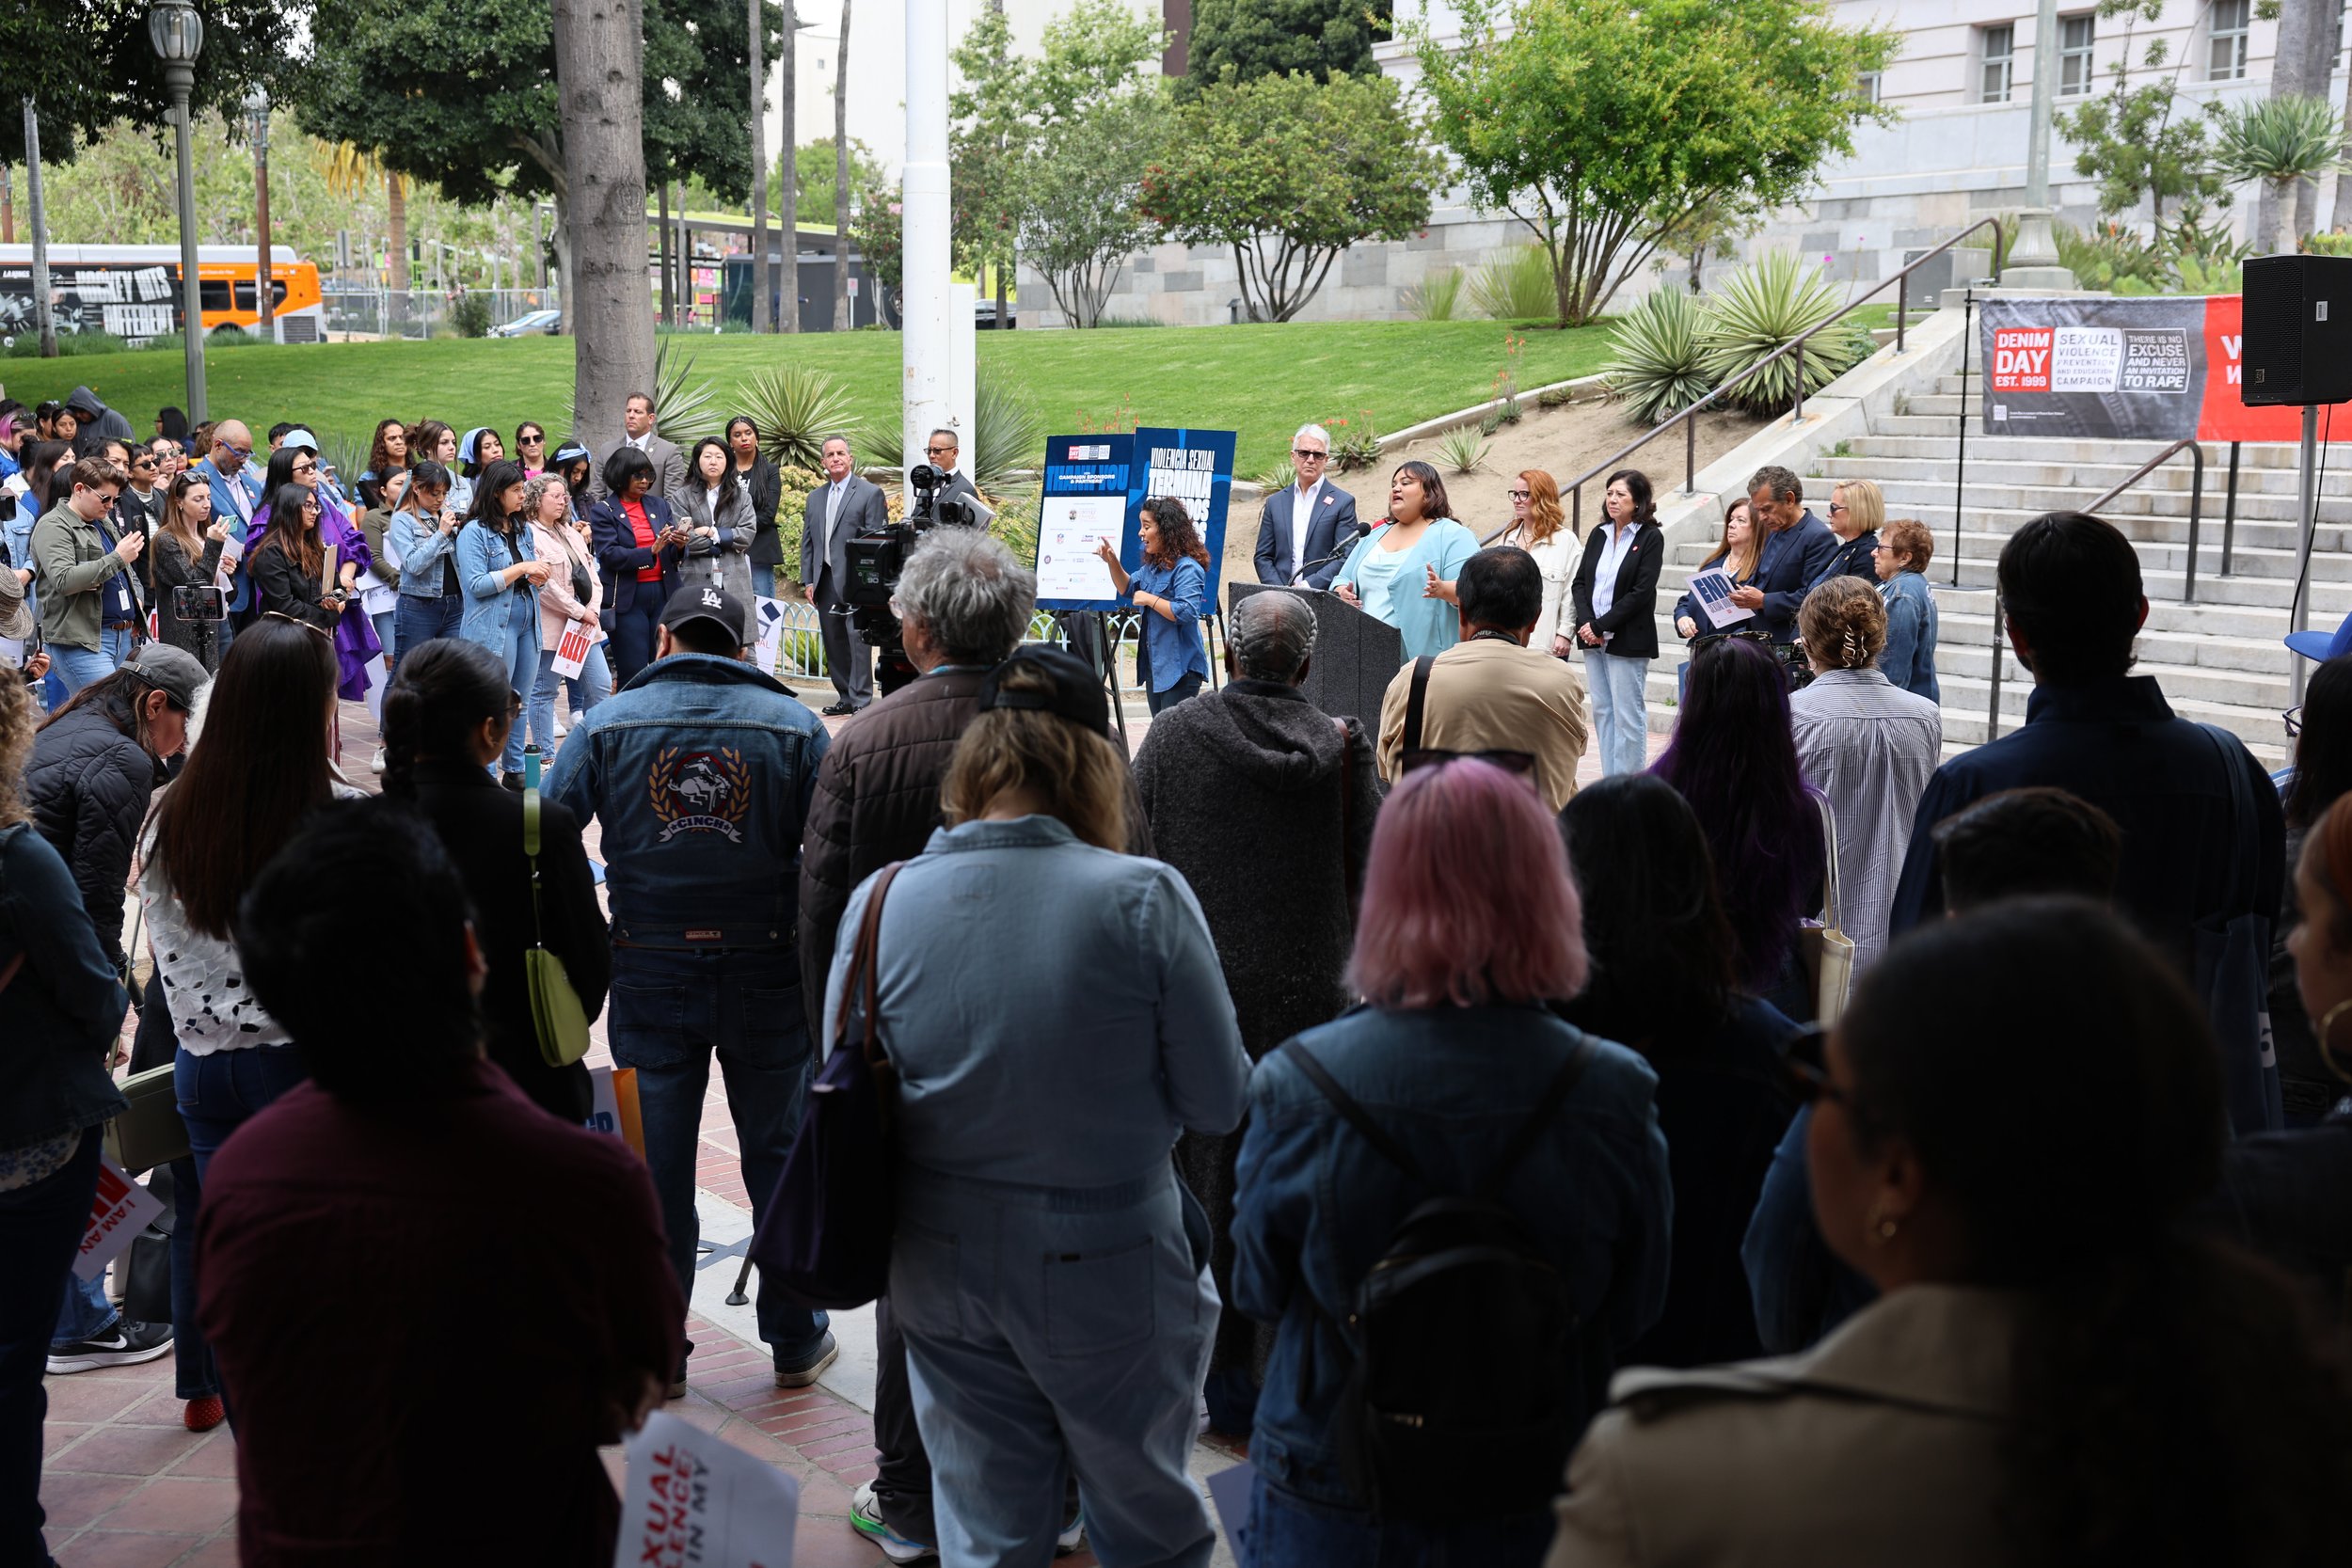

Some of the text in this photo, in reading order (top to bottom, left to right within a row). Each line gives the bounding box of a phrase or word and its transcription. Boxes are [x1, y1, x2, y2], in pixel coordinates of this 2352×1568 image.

[1998, 332, 2050, 348] DENIM
[2059, 334, 2119, 345] SEXUAL
[2128, 335, 2183, 344] THERE IS NO
[2058, 347, 2118, 357] VIOLENCE
[2128, 344, 2185, 357] EXCUSE
[1995, 350, 2049, 374] DAY
[2057, 358, 2115, 367] PREVENTION
[2126, 357, 2185, 367] AND NEVER
[2124, 367, 2185, 375] AN INVITATION
[1994, 375, 2047, 388] EST. 1999
[2056, 376, 2113, 386] CAMPAIGN
[2123, 375, 2185, 388] TO RAPE
[1150, 448, 1215, 470] VIOLENCIA SEXUAL
[1046, 464, 1130, 492] THANK YOU
[1148, 467, 1213, 499] TERMINA
[1692, 573, 1731, 605] END
[701, 588, 723, 610] LA
[558, 631, 591, 663] ALLY
[676, 816, 724, 832] CINCH
[79, 1199, 136, 1255] I AM AN
[687, 1455, 711, 1563] IN MY
